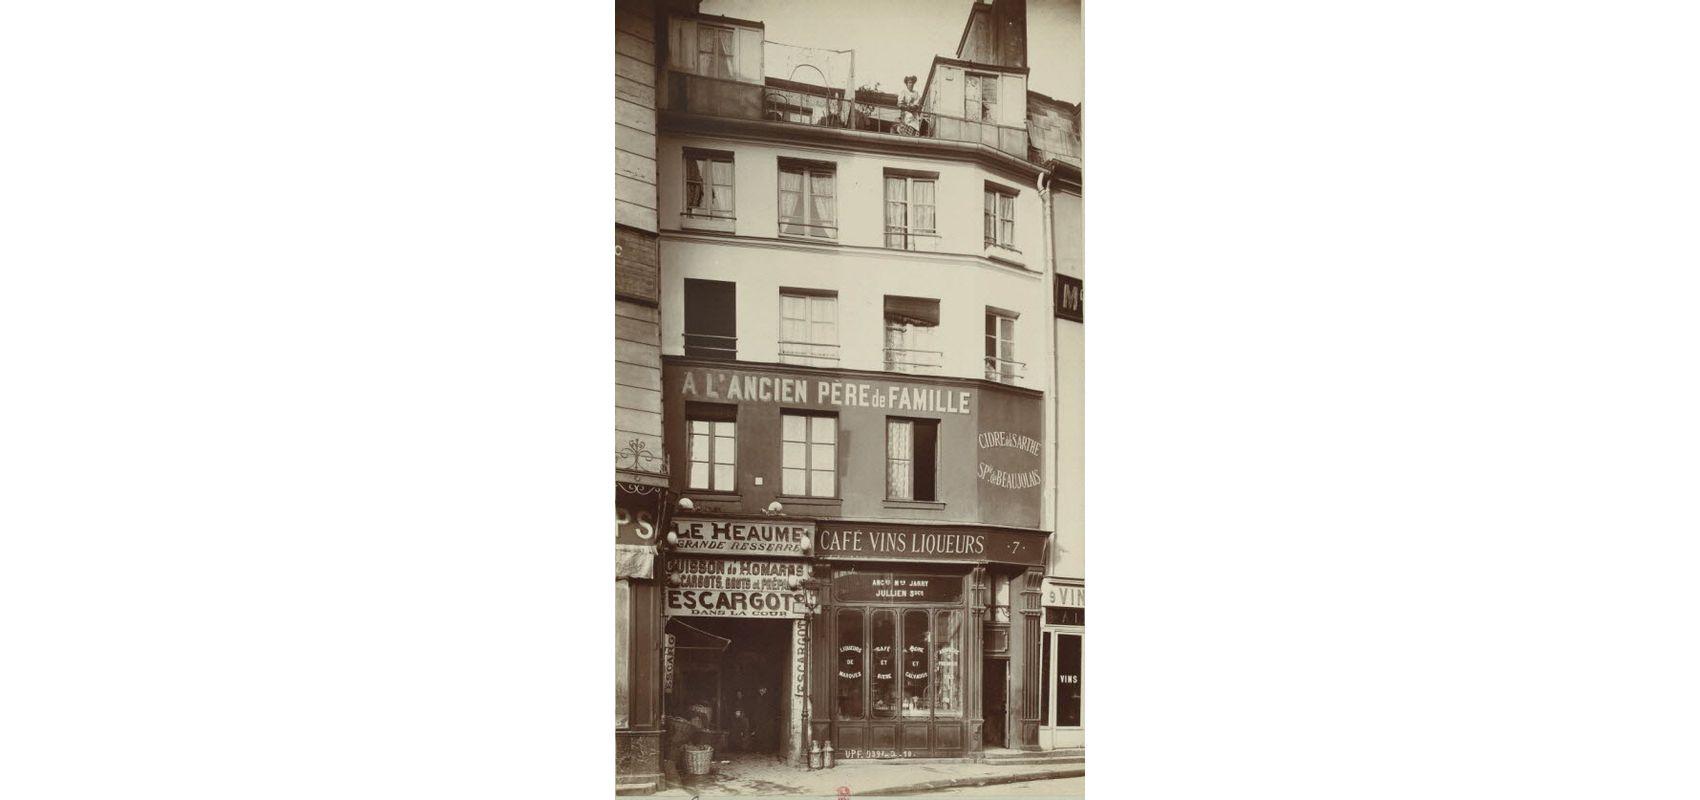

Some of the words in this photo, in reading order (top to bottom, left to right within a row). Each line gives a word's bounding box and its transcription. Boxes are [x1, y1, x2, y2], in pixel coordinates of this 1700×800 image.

[681, 371, 697, 395] A
[705, 374, 807, 403] L'ANCIEN
[817, 380, 870, 407] PÈRE
[872, 389, 886, 408] de
[888, 386, 970, 414] FAMILLE
[979, 431, 1005, 449] CIDRE
[1012, 433, 1041, 457] SARTHE
[996, 469, 1041, 490] BEAUJOLAIS
[672, 522, 704, 540] LE
[711, 522, 804, 543] HEAUME
[677, 540, 726, 549] GRANDE
[731, 542, 801, 553] RESSERRE
[820, 530, 862, 551] CAFÉ
[869, 532, 906, 553] VINS
[911, 534, 985, 555] LIQUEURS
[875, 590, 907, 598] JULLIEN
[1050, 590, 1057, 604] 9
[838, 671, 862, 680] MARQUES
[1060, 675, 1079, 684] VINS
